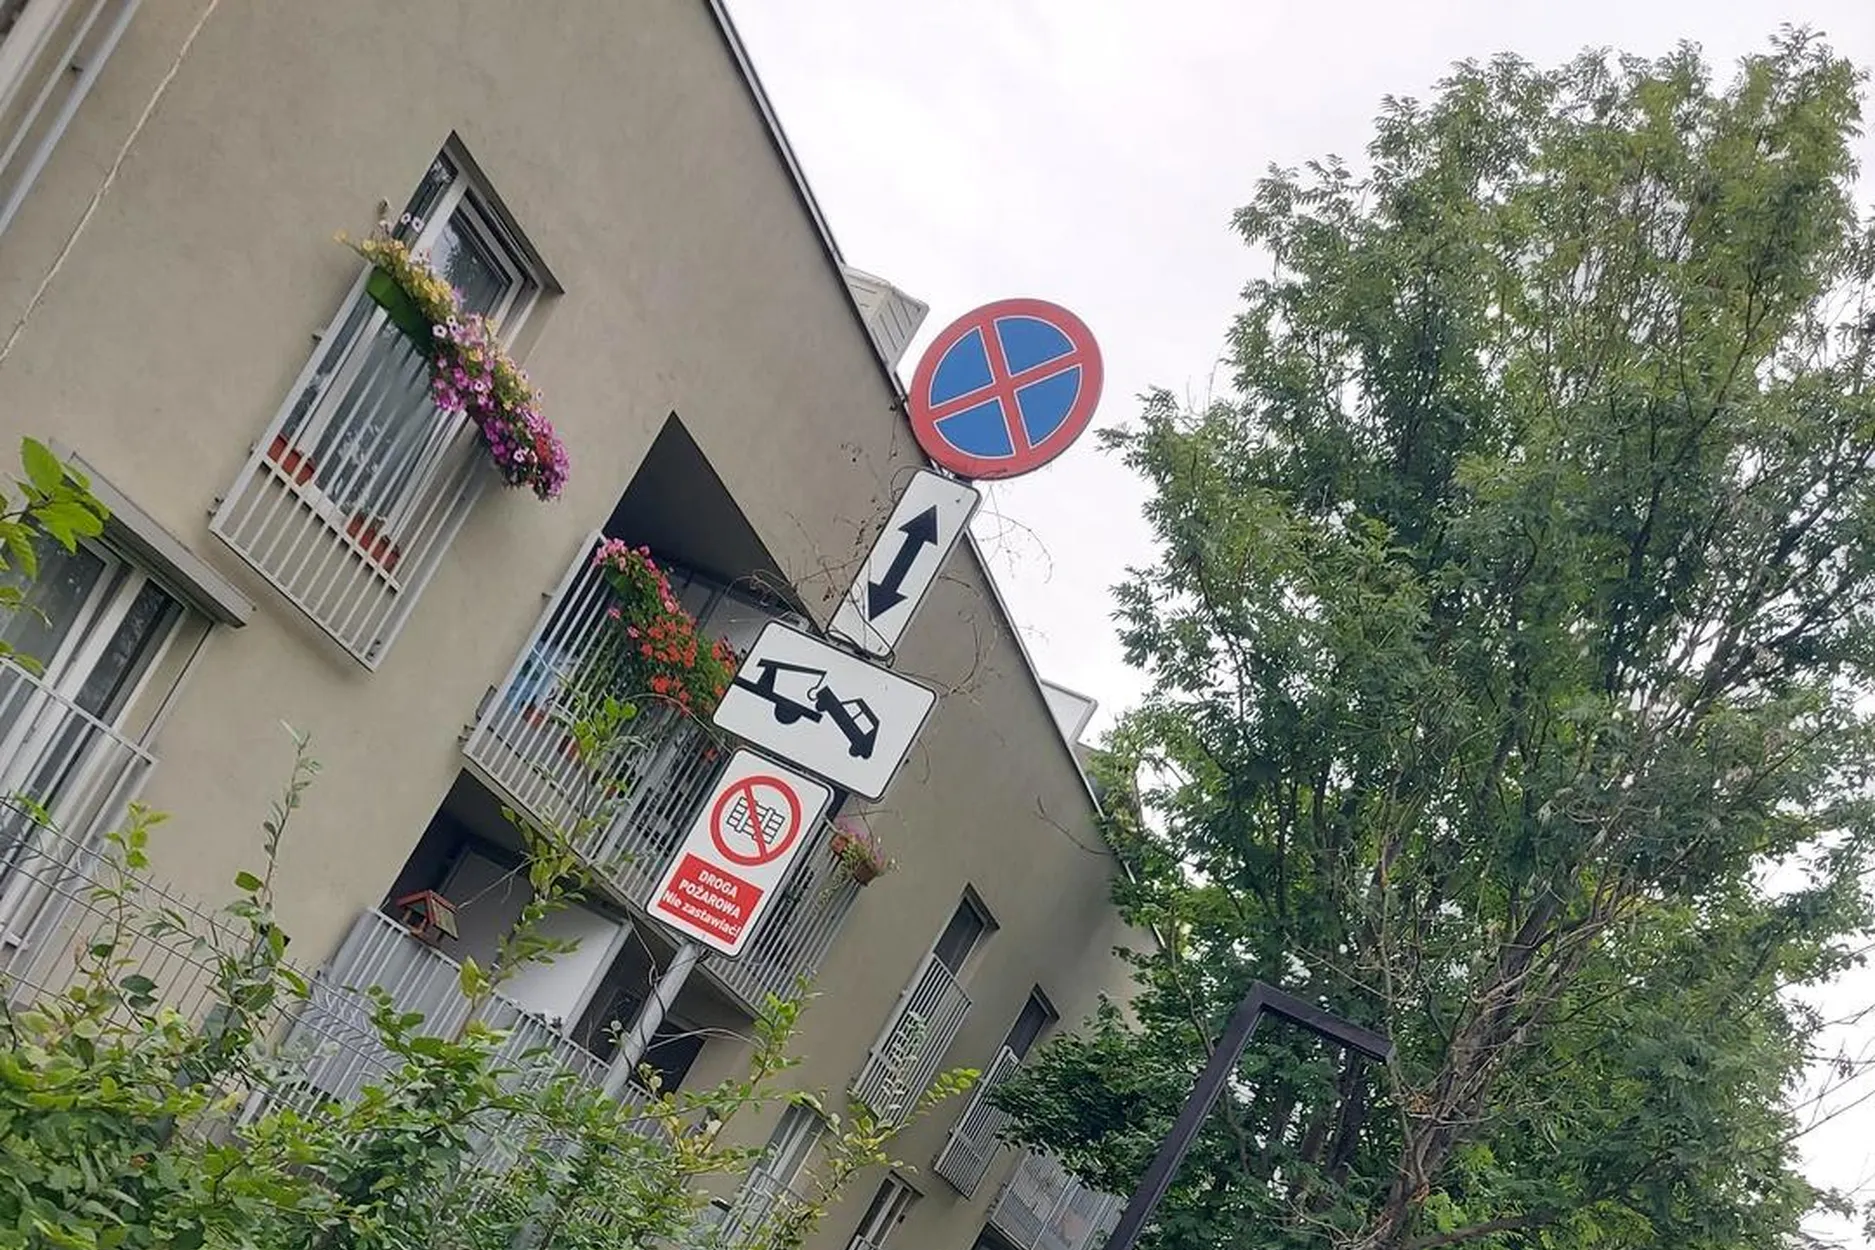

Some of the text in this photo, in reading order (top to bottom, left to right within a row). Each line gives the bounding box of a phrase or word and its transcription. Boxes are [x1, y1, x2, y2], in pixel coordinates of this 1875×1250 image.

[678, 878, 741, 919] POŻAROWA
[698, 870, 738, 899] DROGA
[662, 890, 742, 937] Nie zastawiać!
